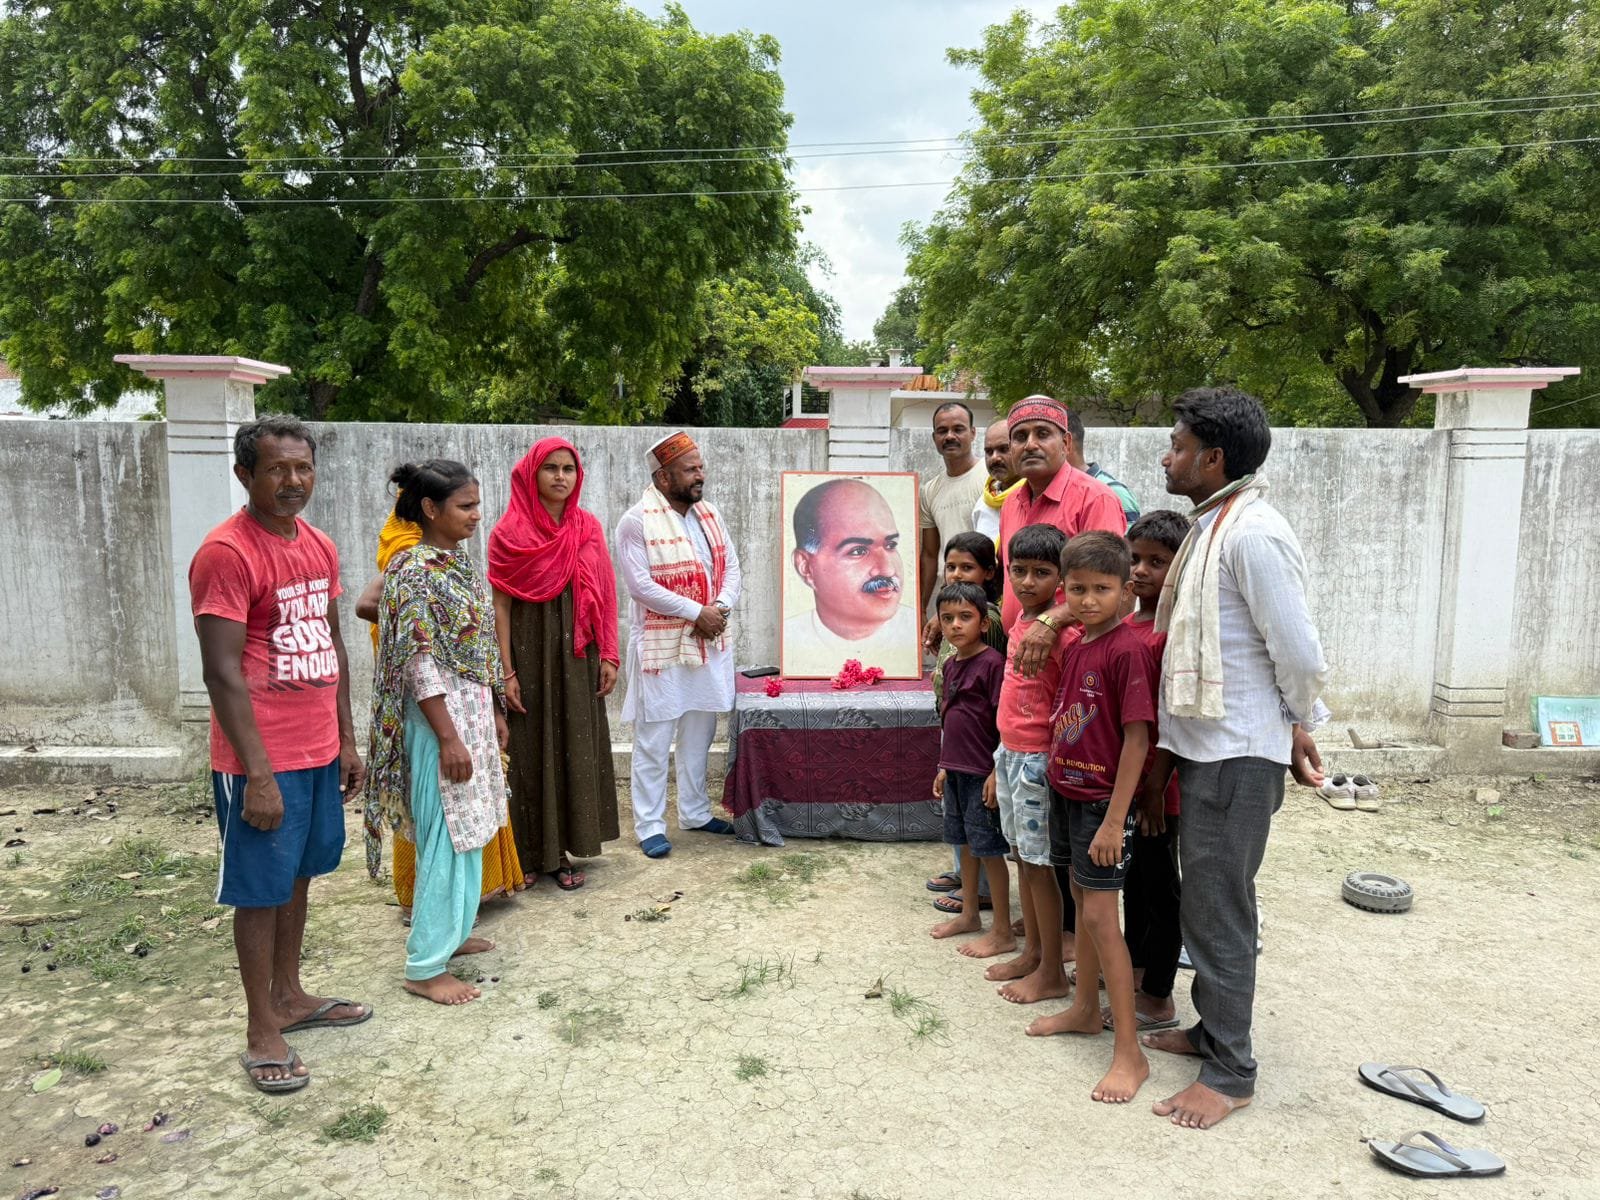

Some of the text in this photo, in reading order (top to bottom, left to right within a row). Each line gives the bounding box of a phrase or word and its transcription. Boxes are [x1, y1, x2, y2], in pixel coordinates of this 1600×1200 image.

[277, 586, 296, 600] YOUR
[277, 650, 339, 680] ENOUG
[1066, 759, 1106, 772] REVOLUTION
